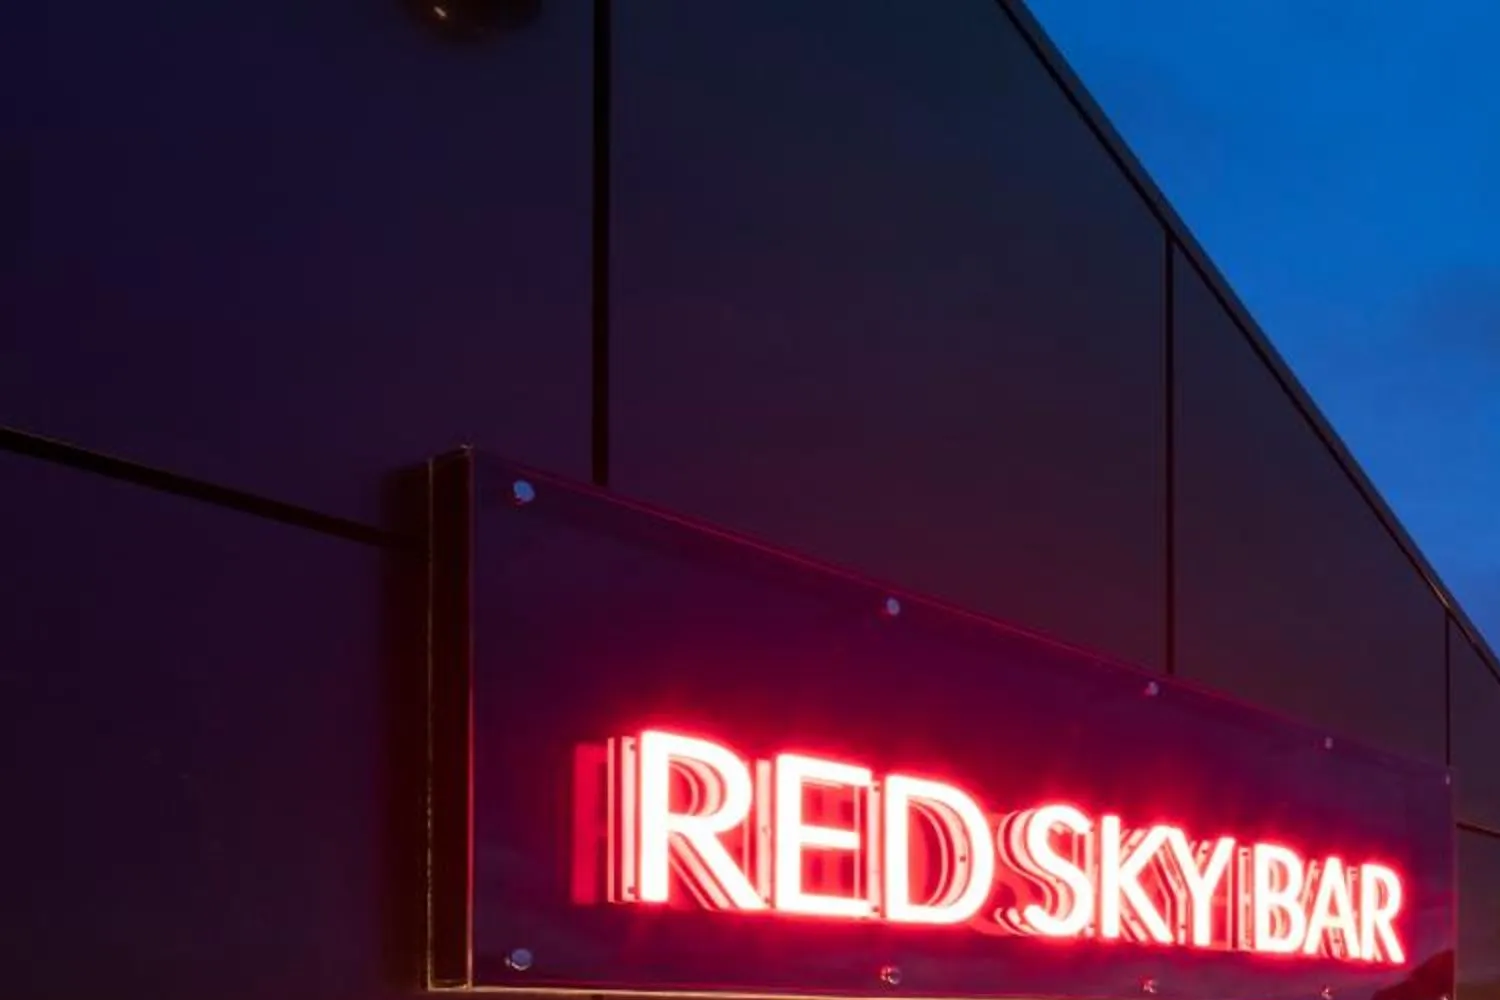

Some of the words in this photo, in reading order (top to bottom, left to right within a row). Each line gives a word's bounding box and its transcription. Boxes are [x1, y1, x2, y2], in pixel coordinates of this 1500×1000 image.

[634, 728, 995, 926] RED
[1022, 802, 1237, 949] SKY
[1253, 842, 1407, 964] BAR
